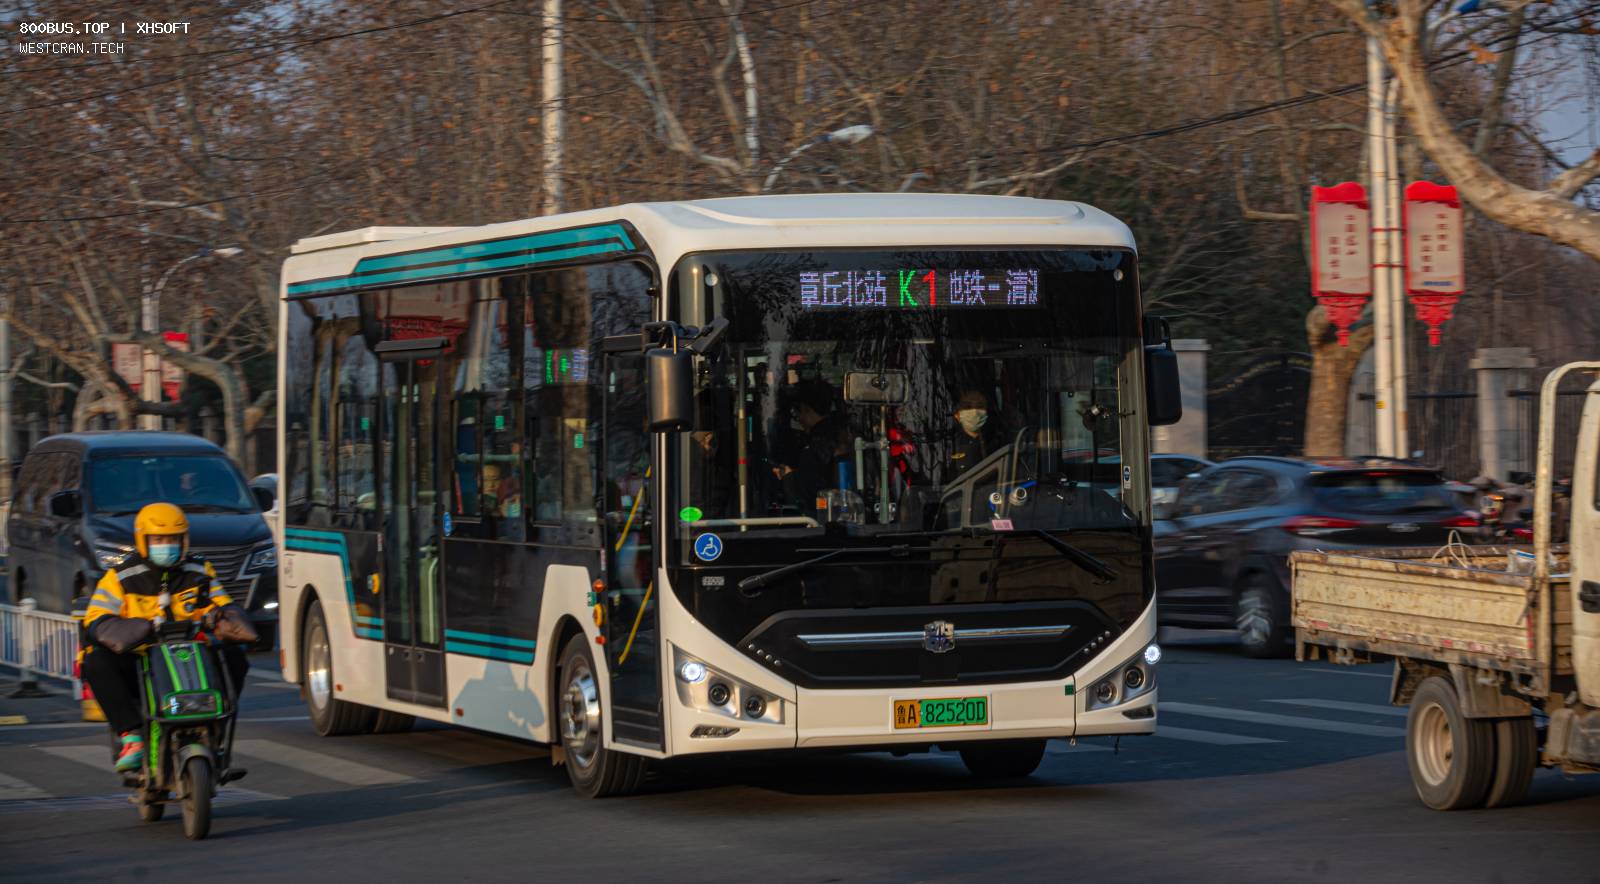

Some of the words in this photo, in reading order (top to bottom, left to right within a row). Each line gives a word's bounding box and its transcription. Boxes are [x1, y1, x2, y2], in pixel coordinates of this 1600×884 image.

[799, 270, 887, 307] 章丘北站
[900, 269, 936, 306] K1
